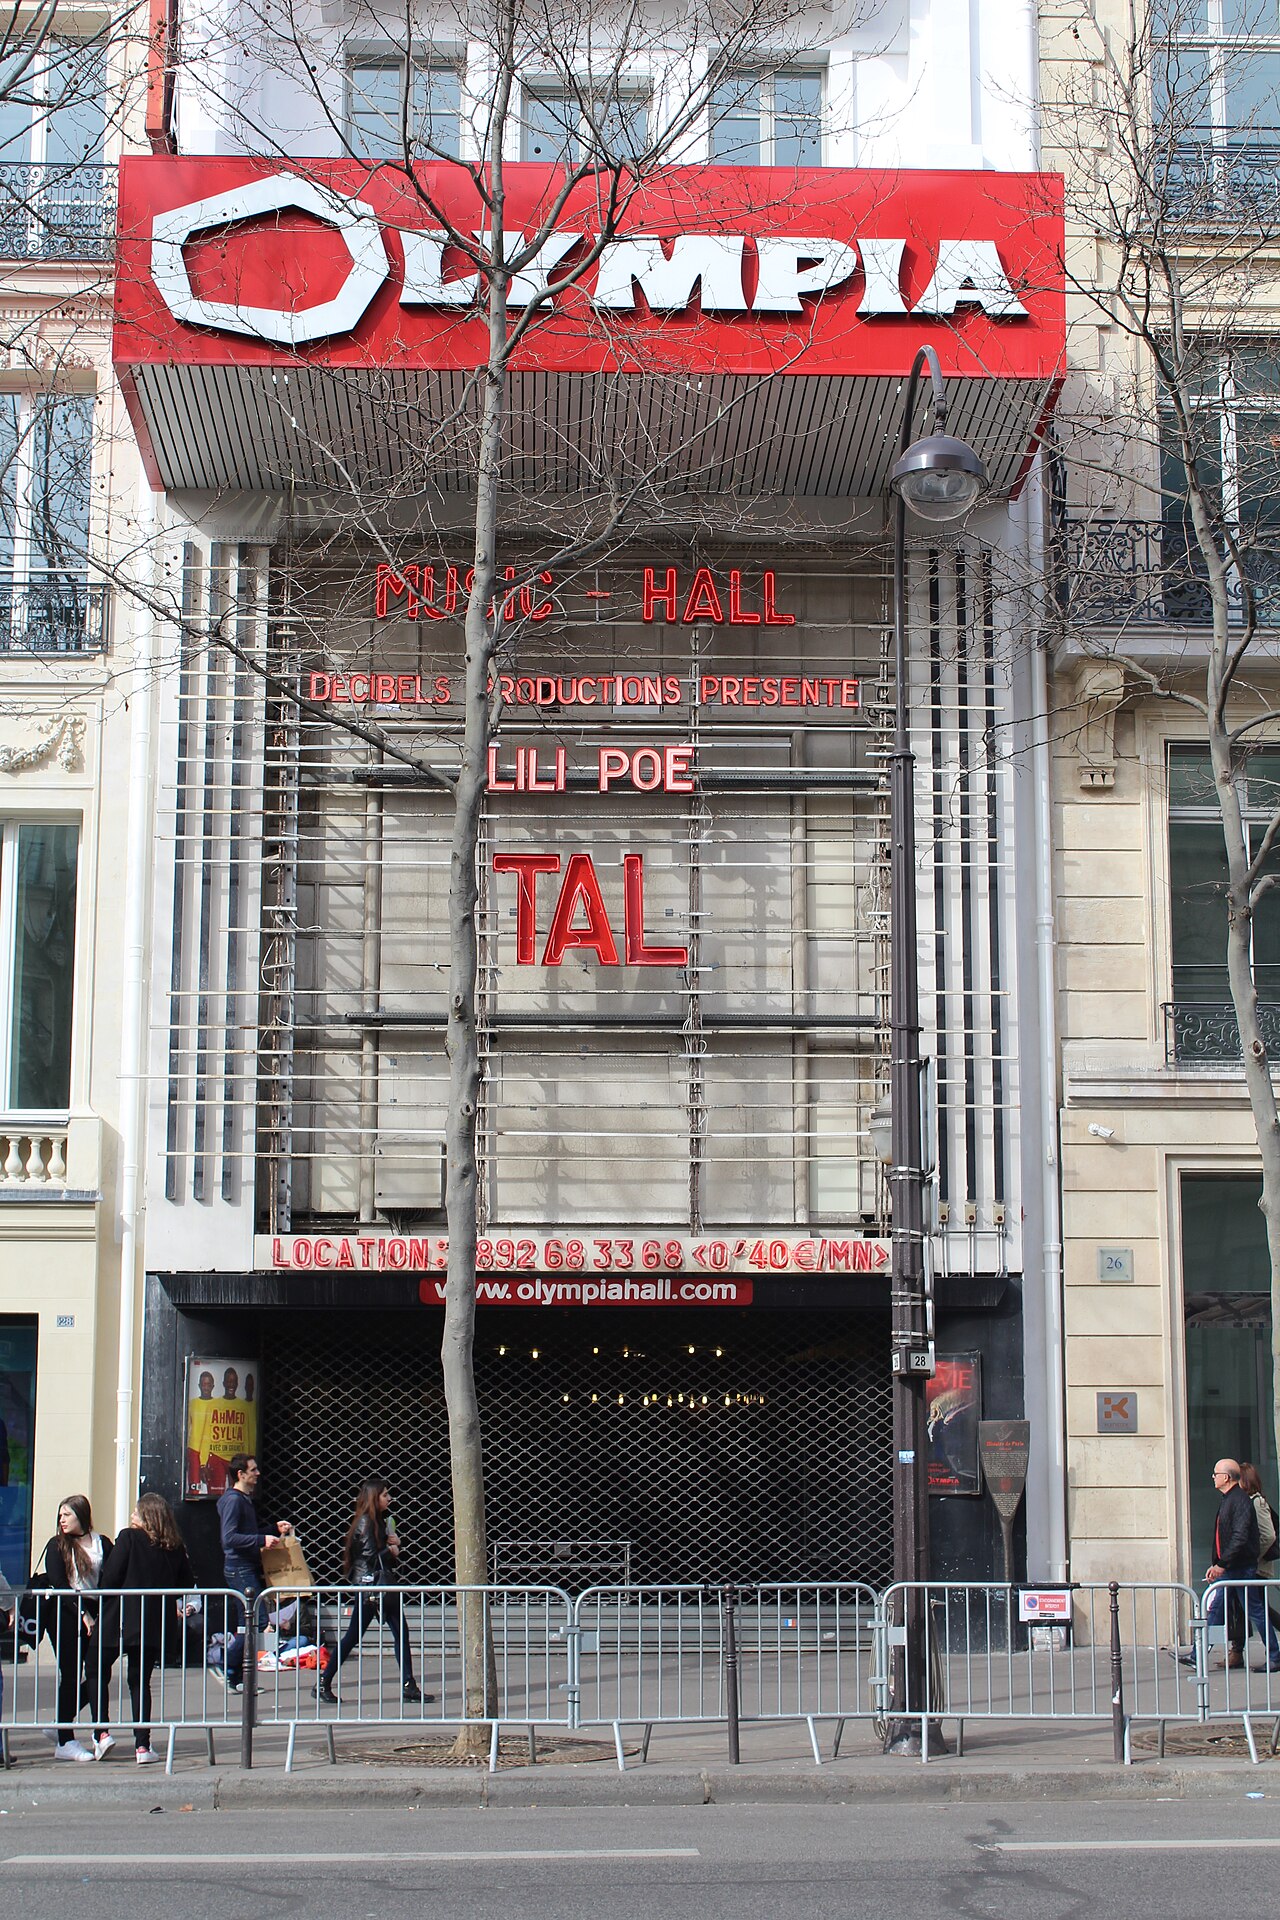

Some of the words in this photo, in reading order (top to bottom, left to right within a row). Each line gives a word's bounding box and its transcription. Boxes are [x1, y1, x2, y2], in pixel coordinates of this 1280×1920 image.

[151, 171, 1029, 344] OLYMPIA
[642, 566, 796, 625] HALL
[309, 671, 451, 704] DECIBELS
[486, 675, 681, 706] RODUCTIONS
[700, 675, 860, 708] PRESENTE
[487, 746, 566, 793] LILI
[598, 746, 694, 793] POE
[493, 853, 688, 967] TAL
[475, 1239, 537, 1269] 892
[544, 1239, 583, 1269] 68
[593, 1240, 634, 1269] 33
[641, 1240, 683, 1270] 68
[1106, 1256, 1122, 1270] 26
[914, 1355, 926, 1367] 28
[211, 1409, 245, 1425] AHMED
[212, 1425, 243, 1441] SYLLA
